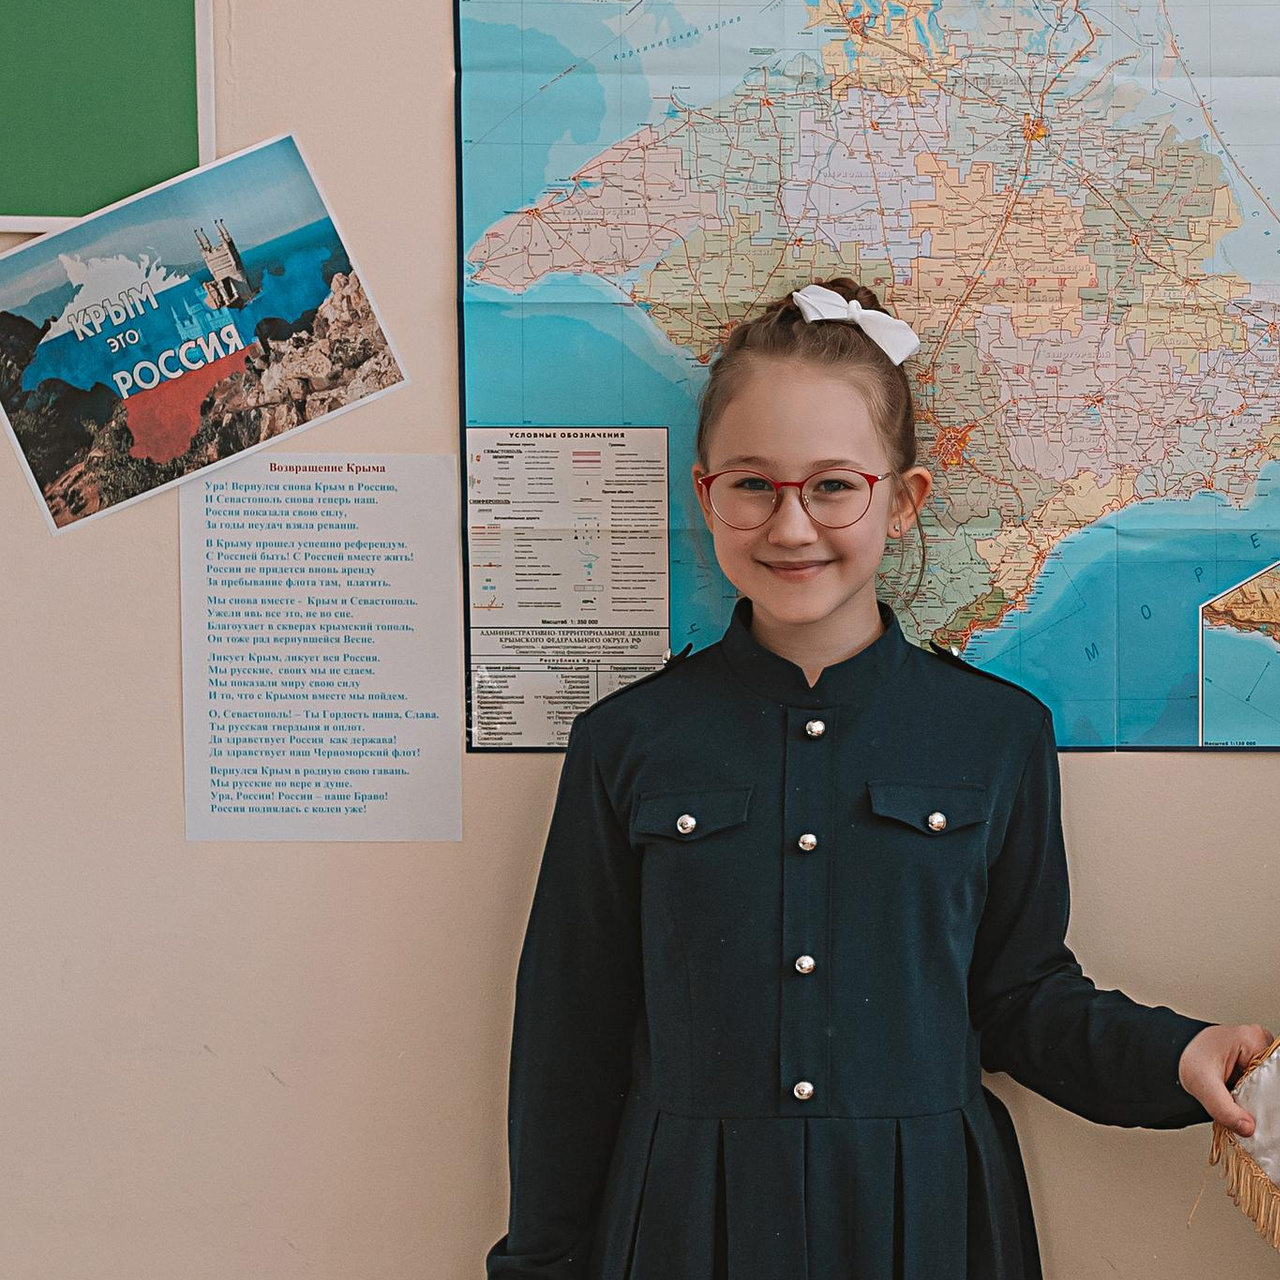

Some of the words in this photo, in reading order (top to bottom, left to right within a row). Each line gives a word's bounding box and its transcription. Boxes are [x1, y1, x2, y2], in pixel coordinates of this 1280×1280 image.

[67, 281, 159, 342] КРЫМ
[106, 329, 140, 354] ЭТО
[112, 323, 245, 400] РОССИЯ
[269, 464, 343, 474] Возвращение
[347, 464, 386, 474] Крыма
[1085, 533, 1260, 661] МОРЕ
